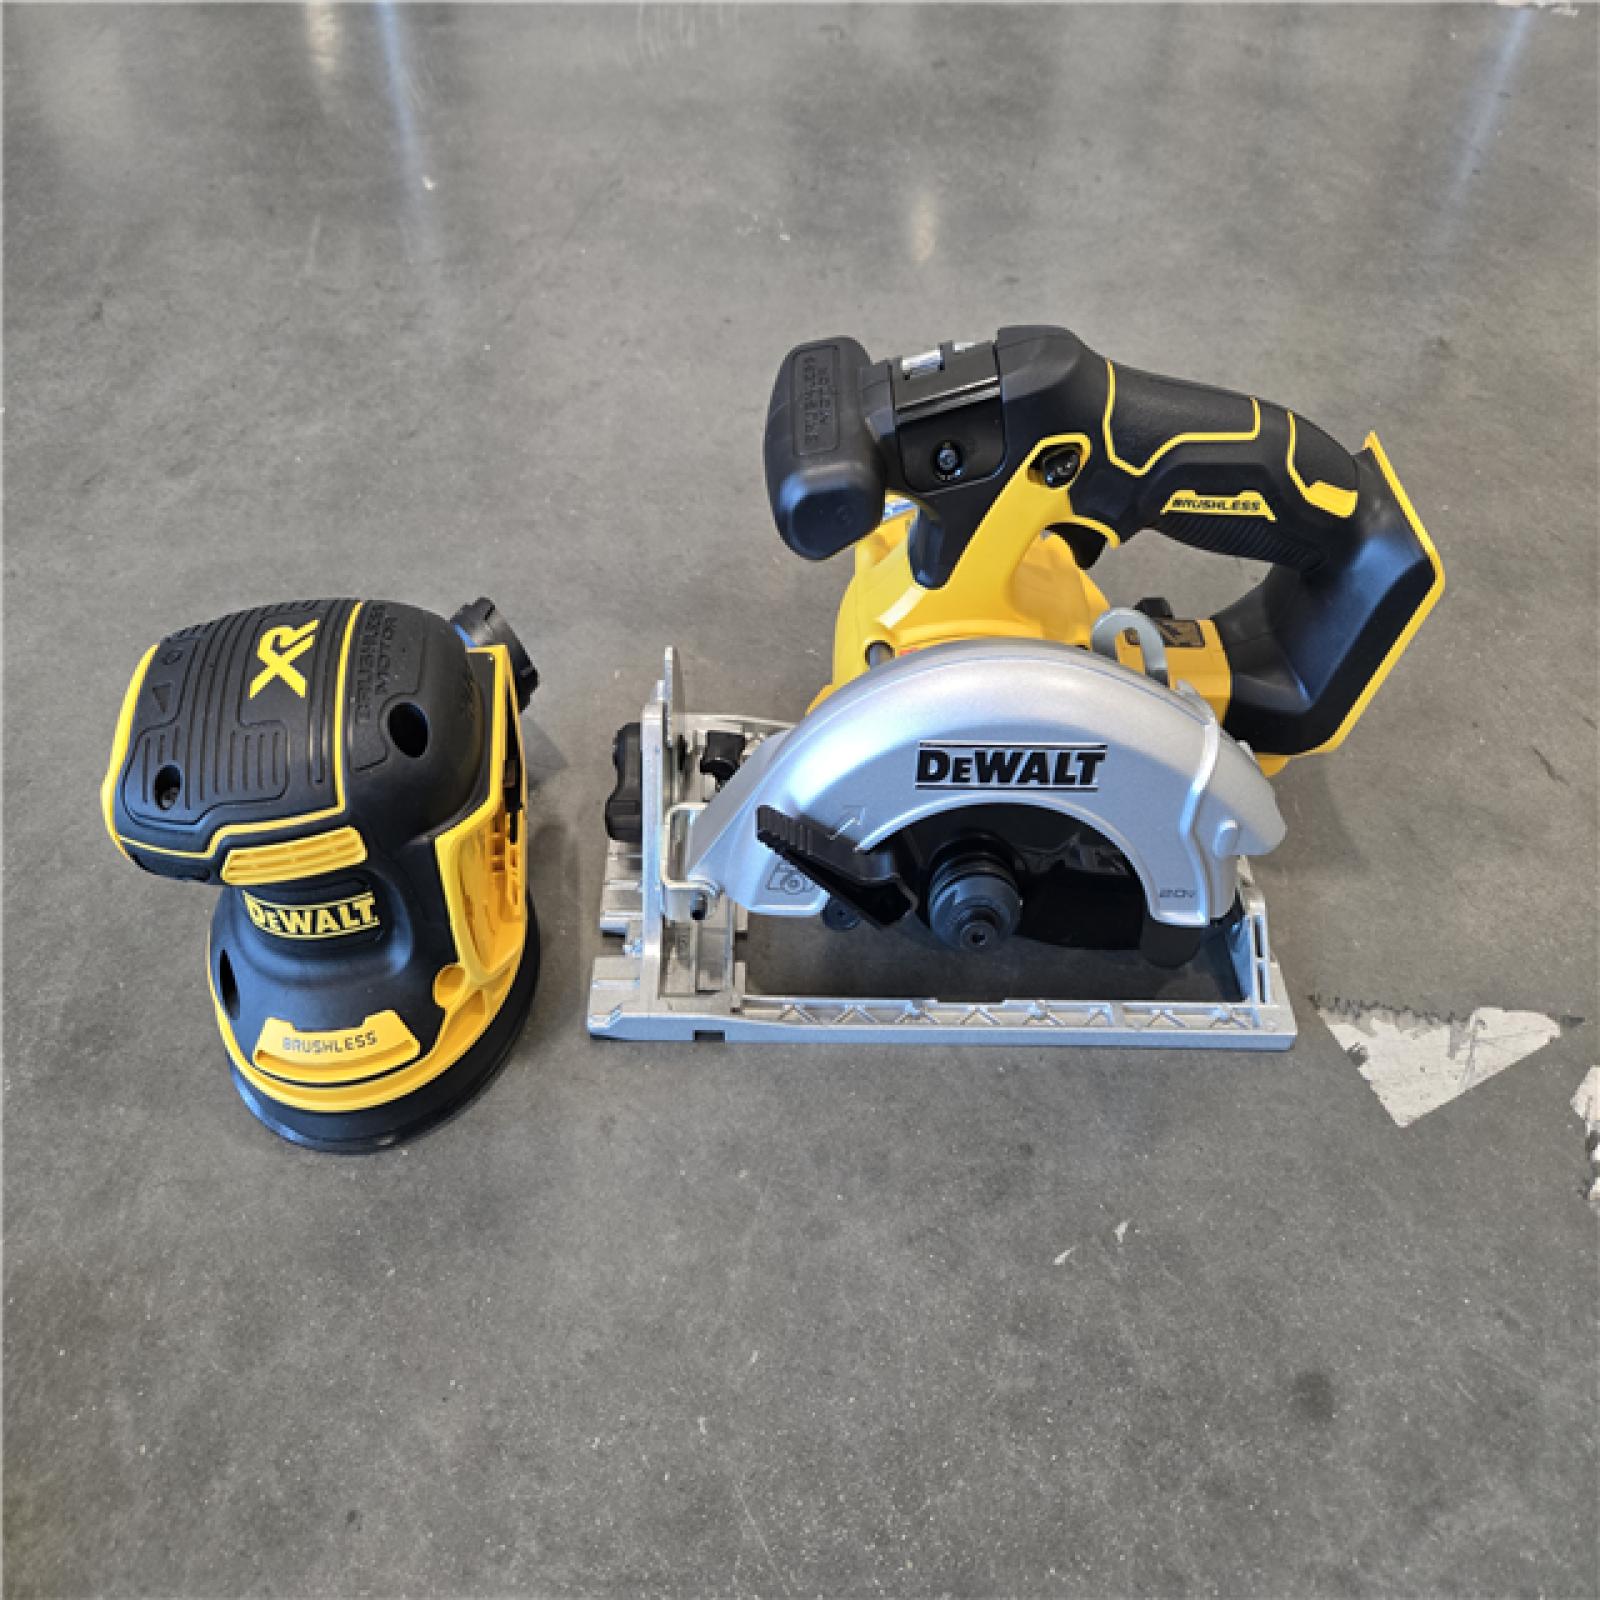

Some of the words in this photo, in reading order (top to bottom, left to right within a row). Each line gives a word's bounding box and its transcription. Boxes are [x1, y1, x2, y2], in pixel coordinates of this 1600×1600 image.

[1171, 498, 1261, 511] BRUSHLESS
[248, 618, 319, 699] XR
[282, 1030, 378, 1054] BRUSHLESS
